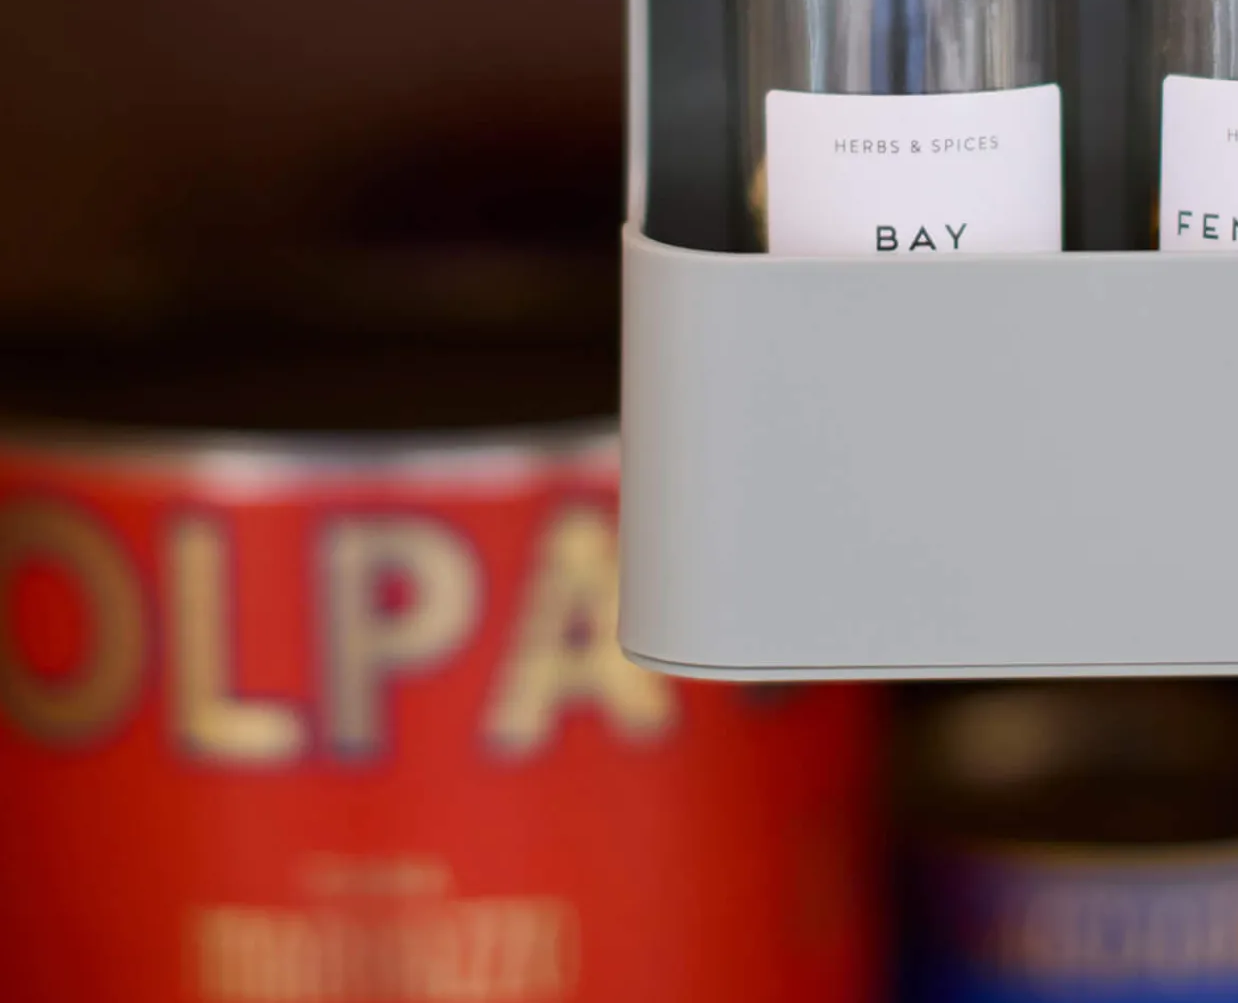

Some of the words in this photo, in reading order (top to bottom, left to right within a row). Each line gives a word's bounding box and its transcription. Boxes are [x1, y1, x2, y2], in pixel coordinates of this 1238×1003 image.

[834, 138, 900, 155] HERBS
[910, 139, 922, 154] &
[931, 135, 999, 154] SPICES
[875, 222, 968, 251] BAY
